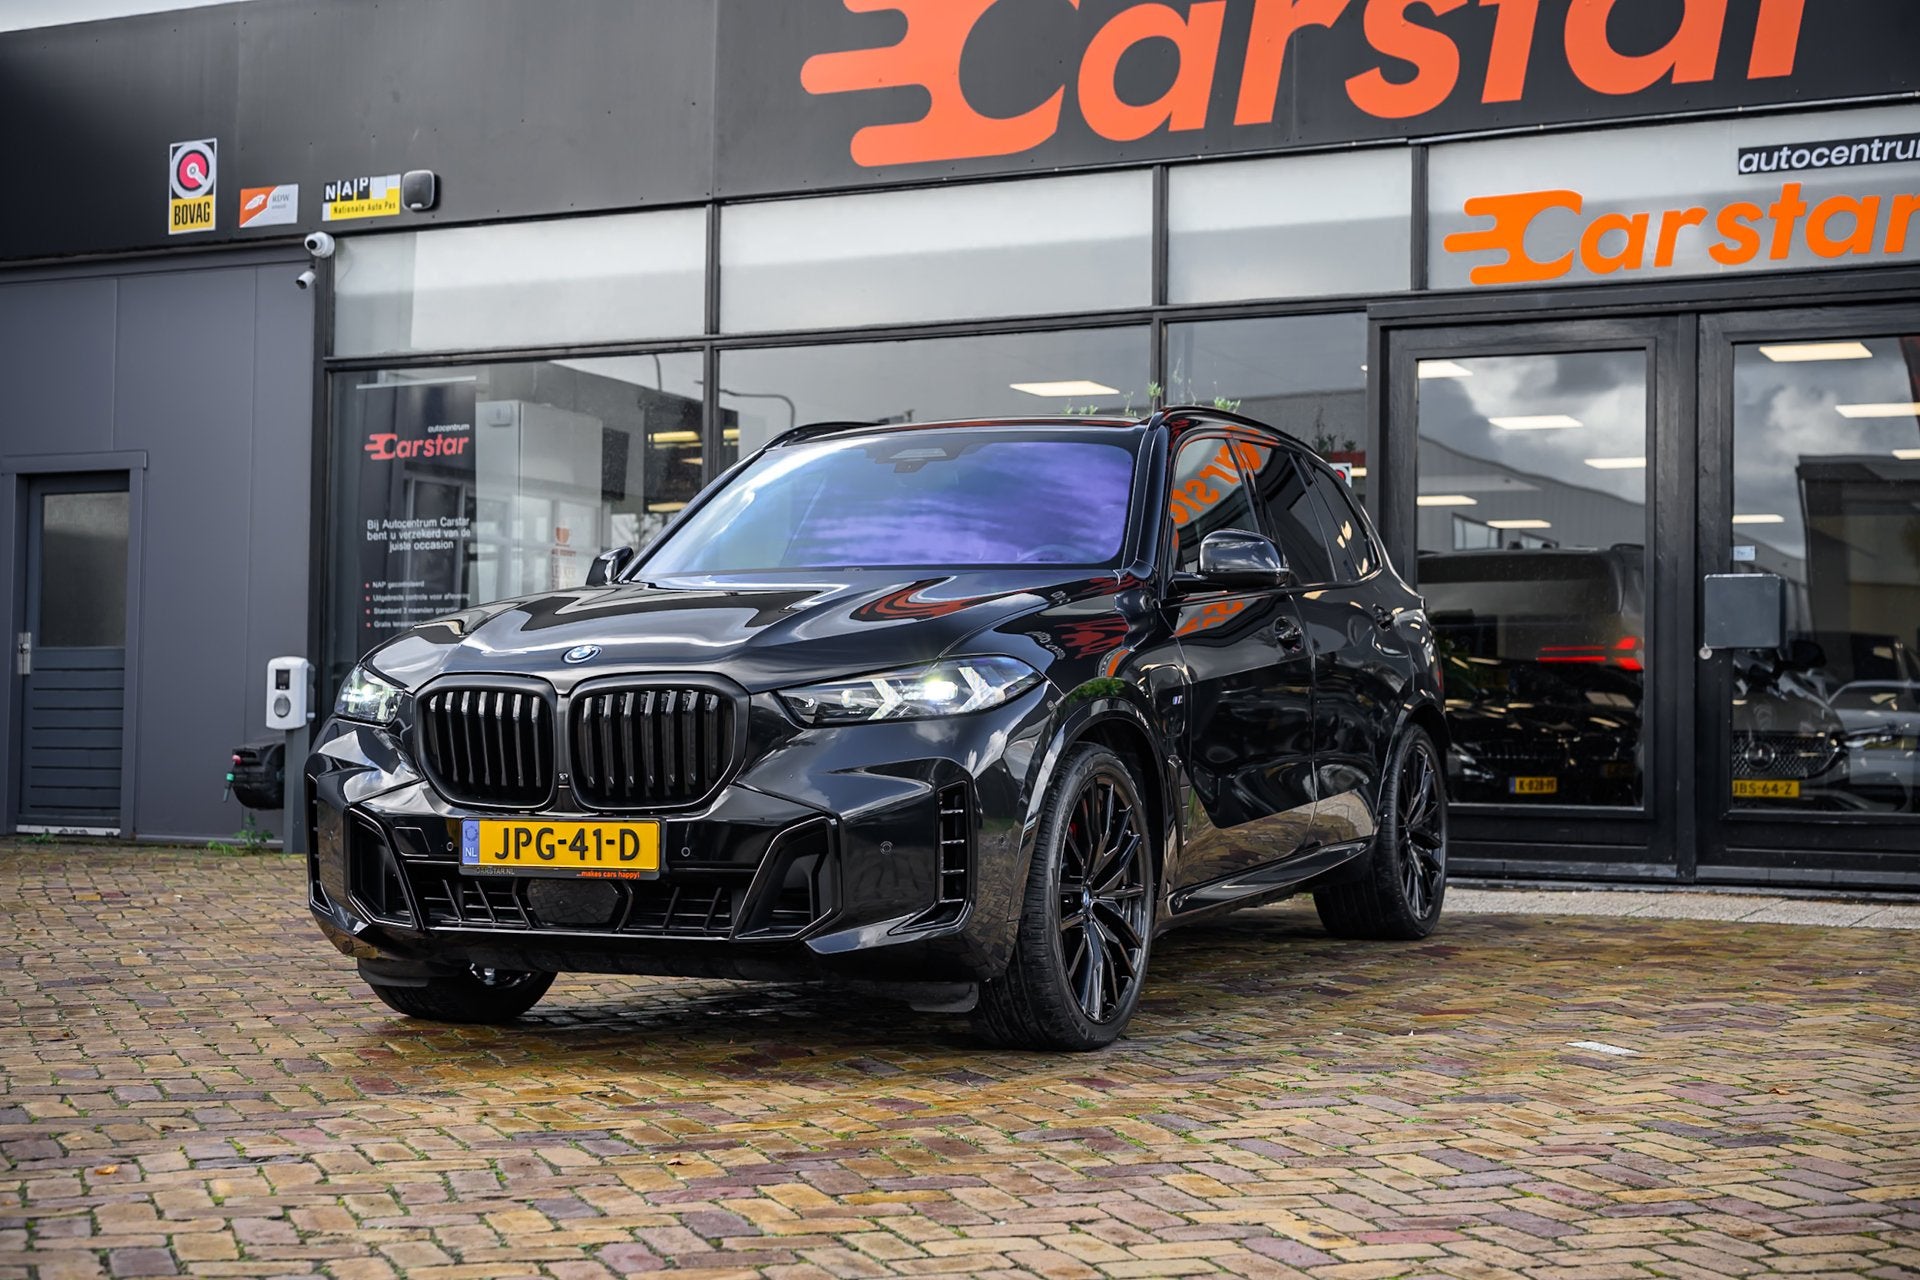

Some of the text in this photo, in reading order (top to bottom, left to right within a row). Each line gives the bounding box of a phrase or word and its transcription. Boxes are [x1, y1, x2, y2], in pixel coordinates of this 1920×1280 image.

[1739, 137, 1920, 173] autocentru
[174, 201, 210, 226] BOVAG
[333, 201, 396, 214] Nationale Auto Pas
[1443, 182, 1920, 285] Carstar
[427, 423, 470, 433] autocentrum
[364, 433, 470, 460] Carstar
[367, 516, 470, 531] Bij Autocentrum Carstar
[367, 528, 471, 541] bent u verzekerd van de
[389, 540, 454, 553] juiste occasion
[494, 827, 641, 861] JPG-41-D
[465, 847, 477, 857] NL
[617, 870, 640, 879] happy!
